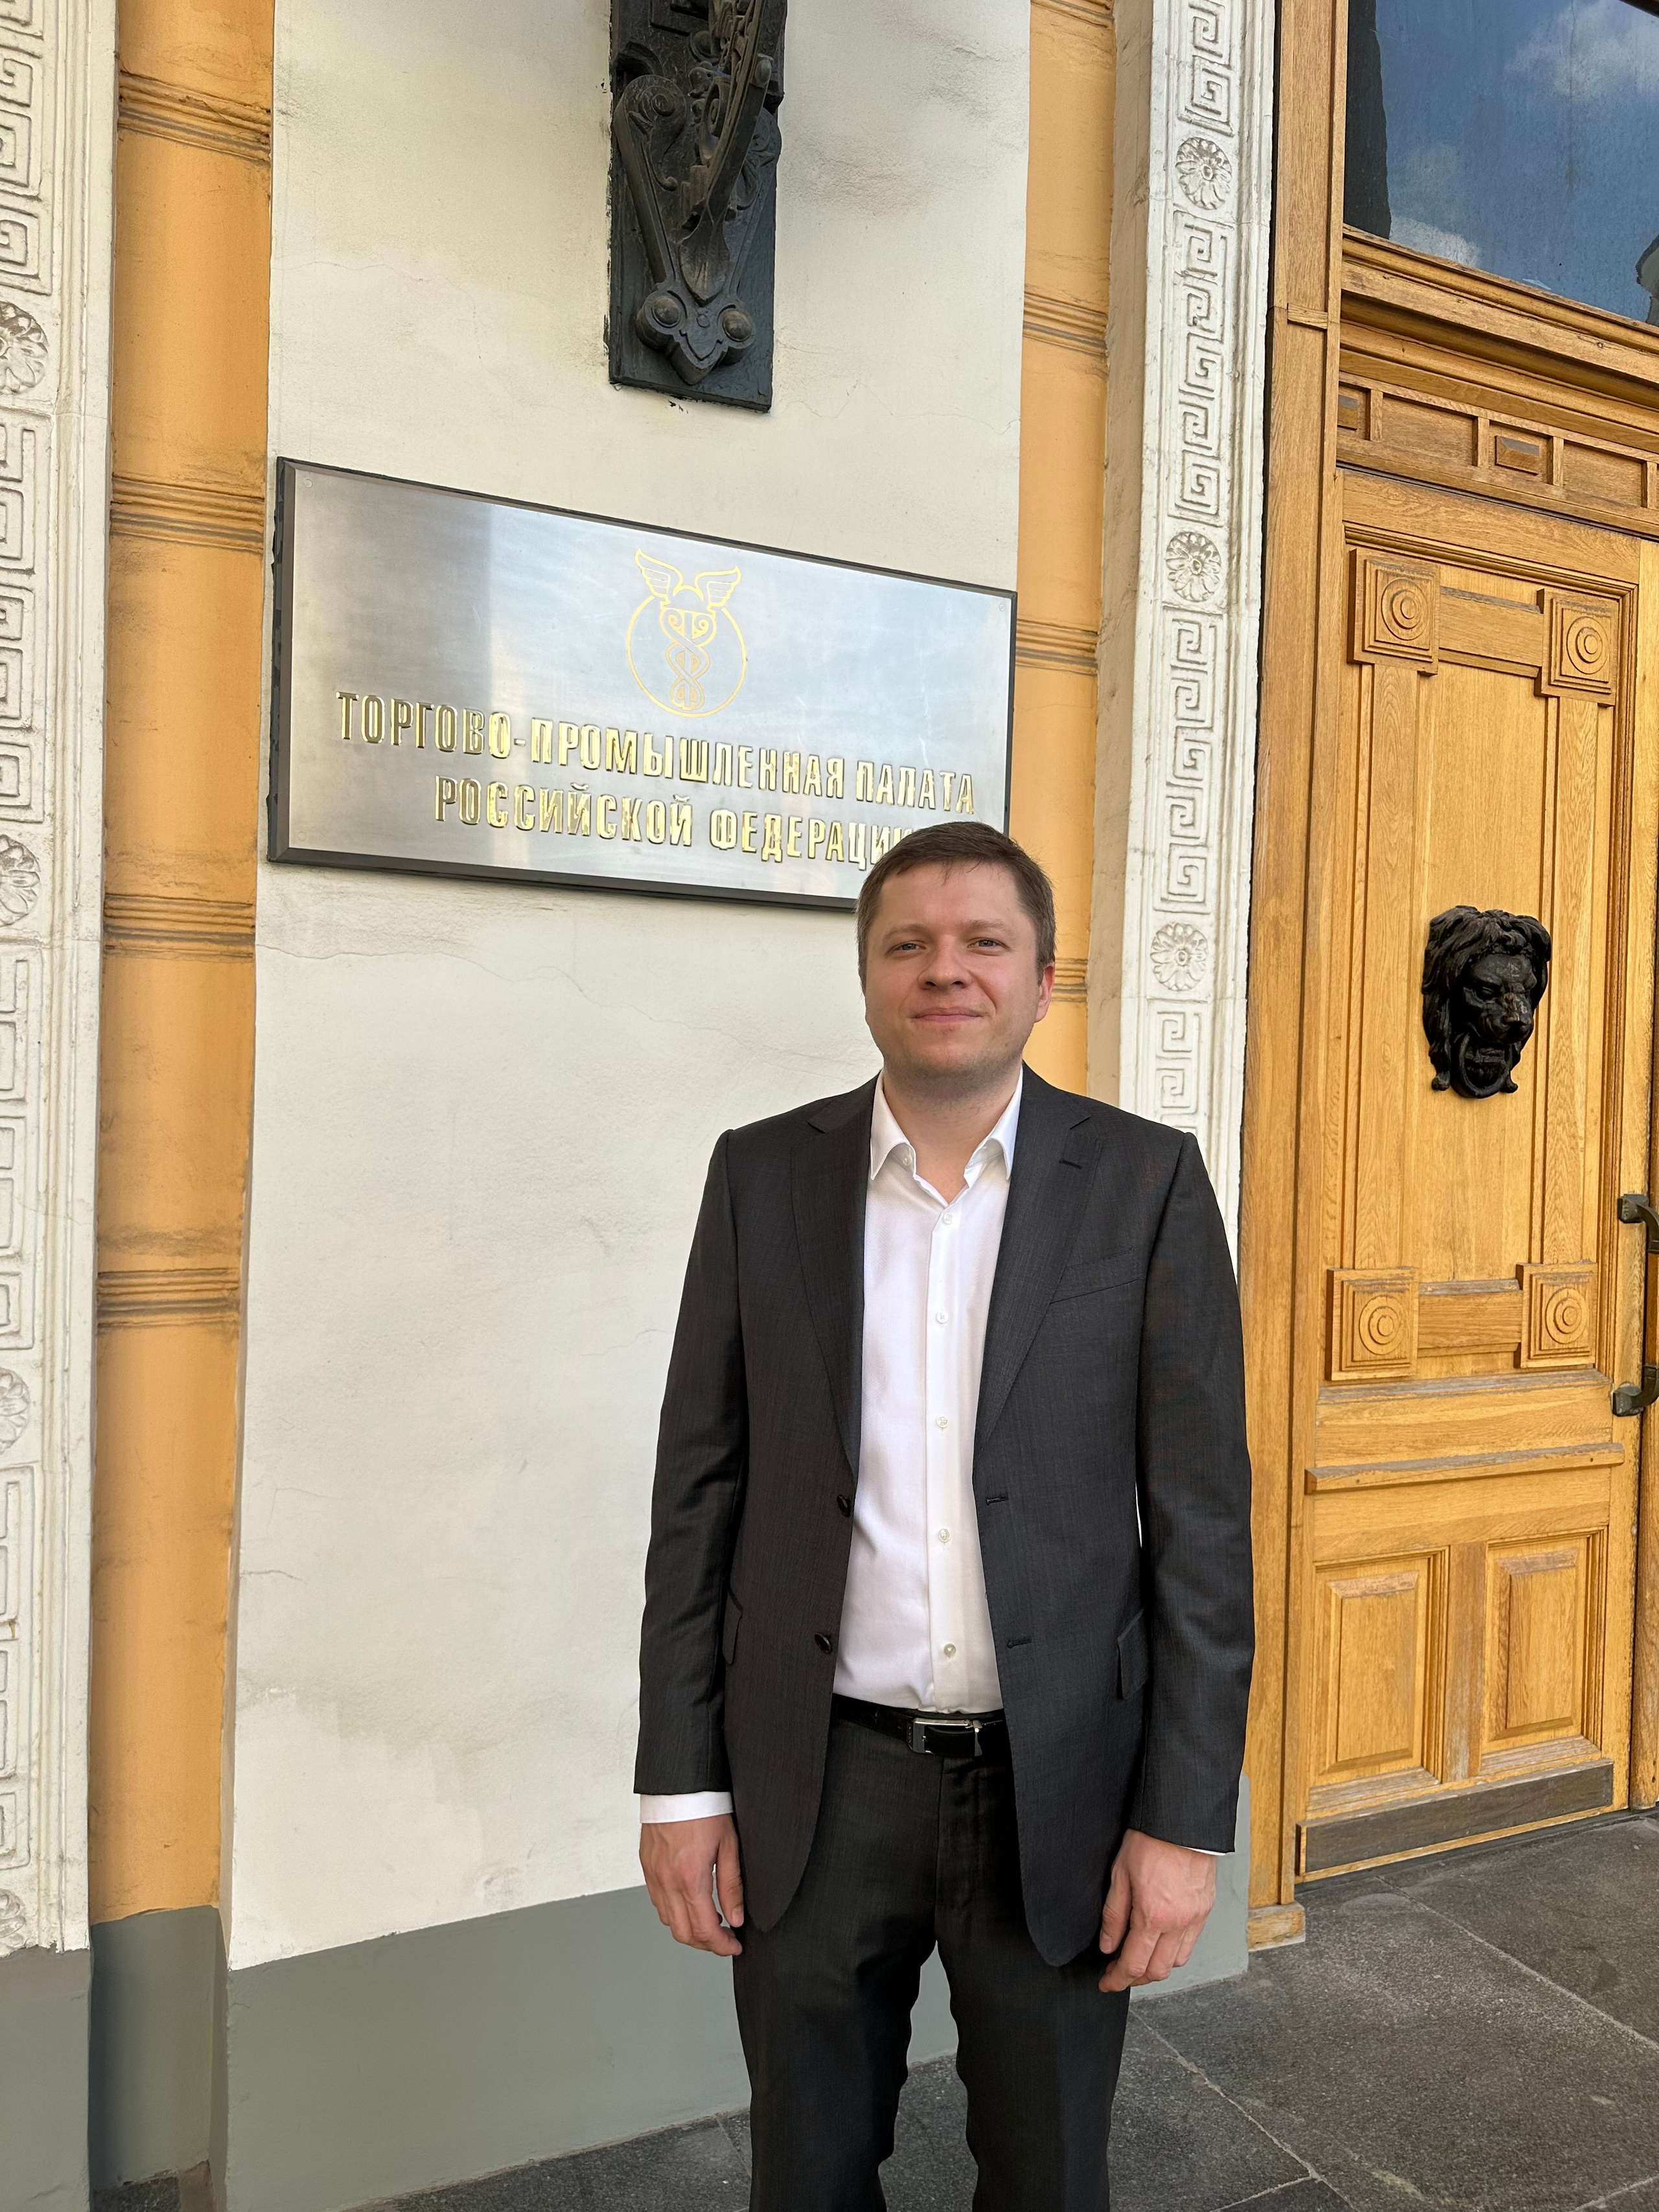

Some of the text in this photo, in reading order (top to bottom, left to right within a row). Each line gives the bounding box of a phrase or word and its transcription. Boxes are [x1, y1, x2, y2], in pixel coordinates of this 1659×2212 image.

[335, 691, 975, 815] ТОРГОВО-ПРОМЫШЛЕННАЯ ПАЛАТА
[435, 775, 693, 846] РОССИЙСКОЙ
